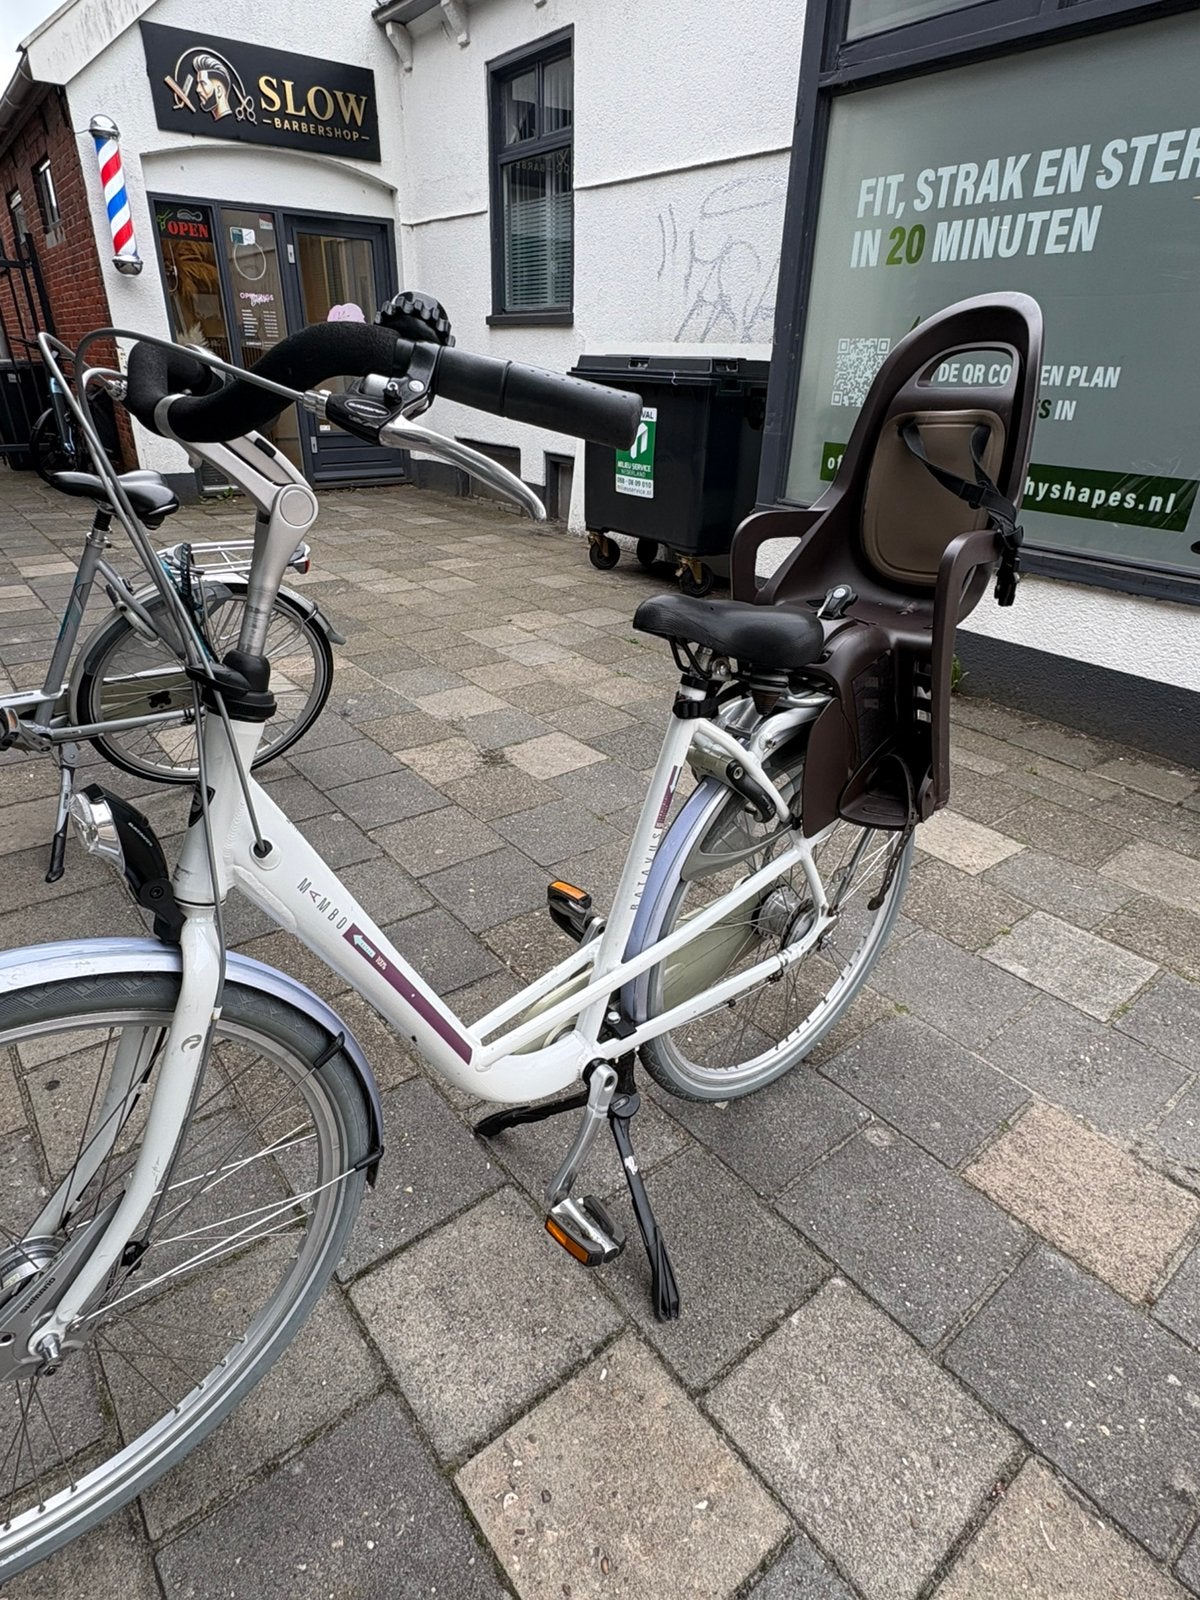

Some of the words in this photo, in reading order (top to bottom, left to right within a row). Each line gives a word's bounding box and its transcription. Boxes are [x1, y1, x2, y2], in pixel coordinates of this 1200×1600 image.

[258, 75, 368, 128] SLOW
[274, 117, 360, 140] BARBERSHOP
[857, 173, 905, 219] FIT,
[913, 153, 1032, 212] STRAK
[1033, 144, 1092, 197] EN
[167, 220, 209, 238] OPEN
[850, 229, 882, 268] IN
[886, 224, 926, 266] 20
[931, 205, 1103, 263] MINUTEN
[938, 363, 960, 383] DE
[962, 363, 986, 385] QR
[988, 364, 1012, 385] CO
[1040, 365, 1065, 386] EN
[1066, 365, 1121, 389] PLAN
[641, 410, 654, 419] VAL
[1053, 400, 1077, 421] IN
[631, 462, 652, 473] SERVICE
[1024, 476, 1177, 514] hyshapes.nl
[630, 832, 661, 910] BATAVUS
[296, 877, 348, 930] MAMBO
